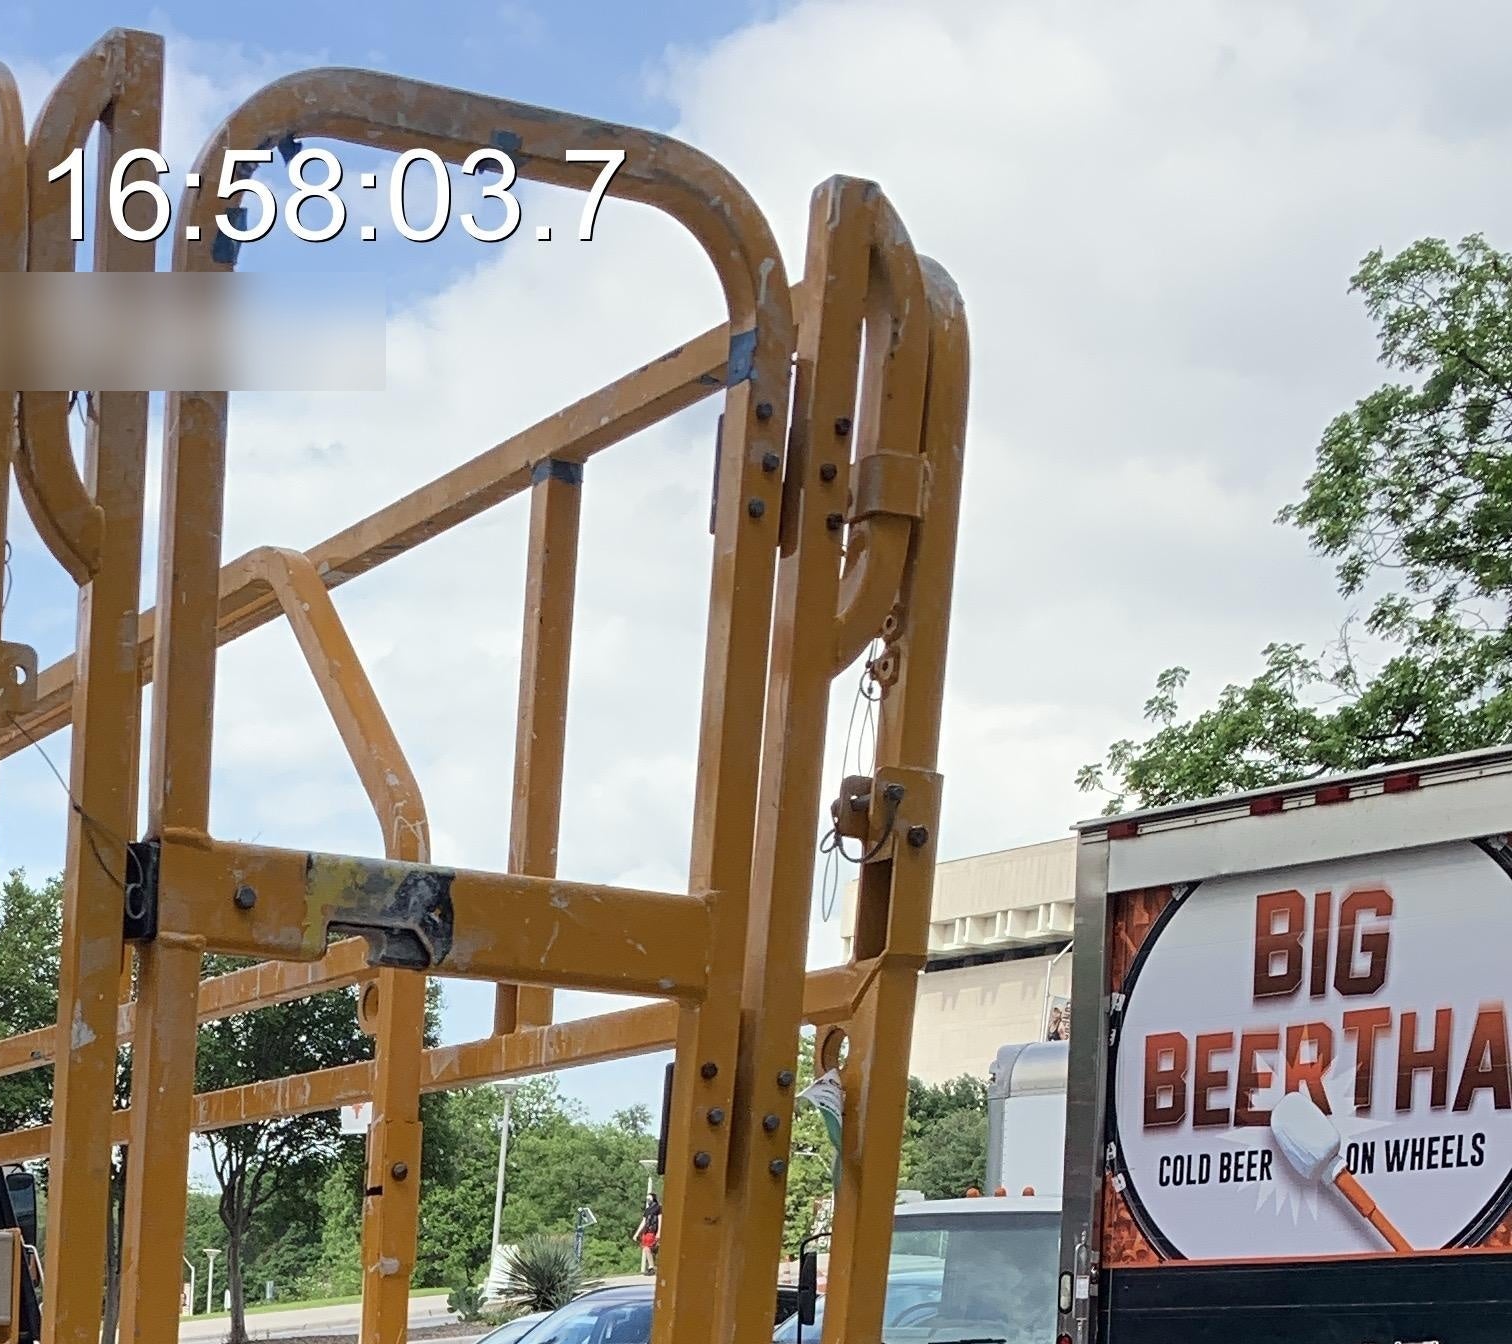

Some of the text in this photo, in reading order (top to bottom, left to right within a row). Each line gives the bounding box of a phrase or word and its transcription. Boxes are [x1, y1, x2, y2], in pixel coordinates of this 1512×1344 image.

[1253, 887, 1394, 998] BIG
[1143, 1008, 1512, 1128] BEERTHA
[1158, 1131, 1486, 1187] COLD BEER ON WHEELS
